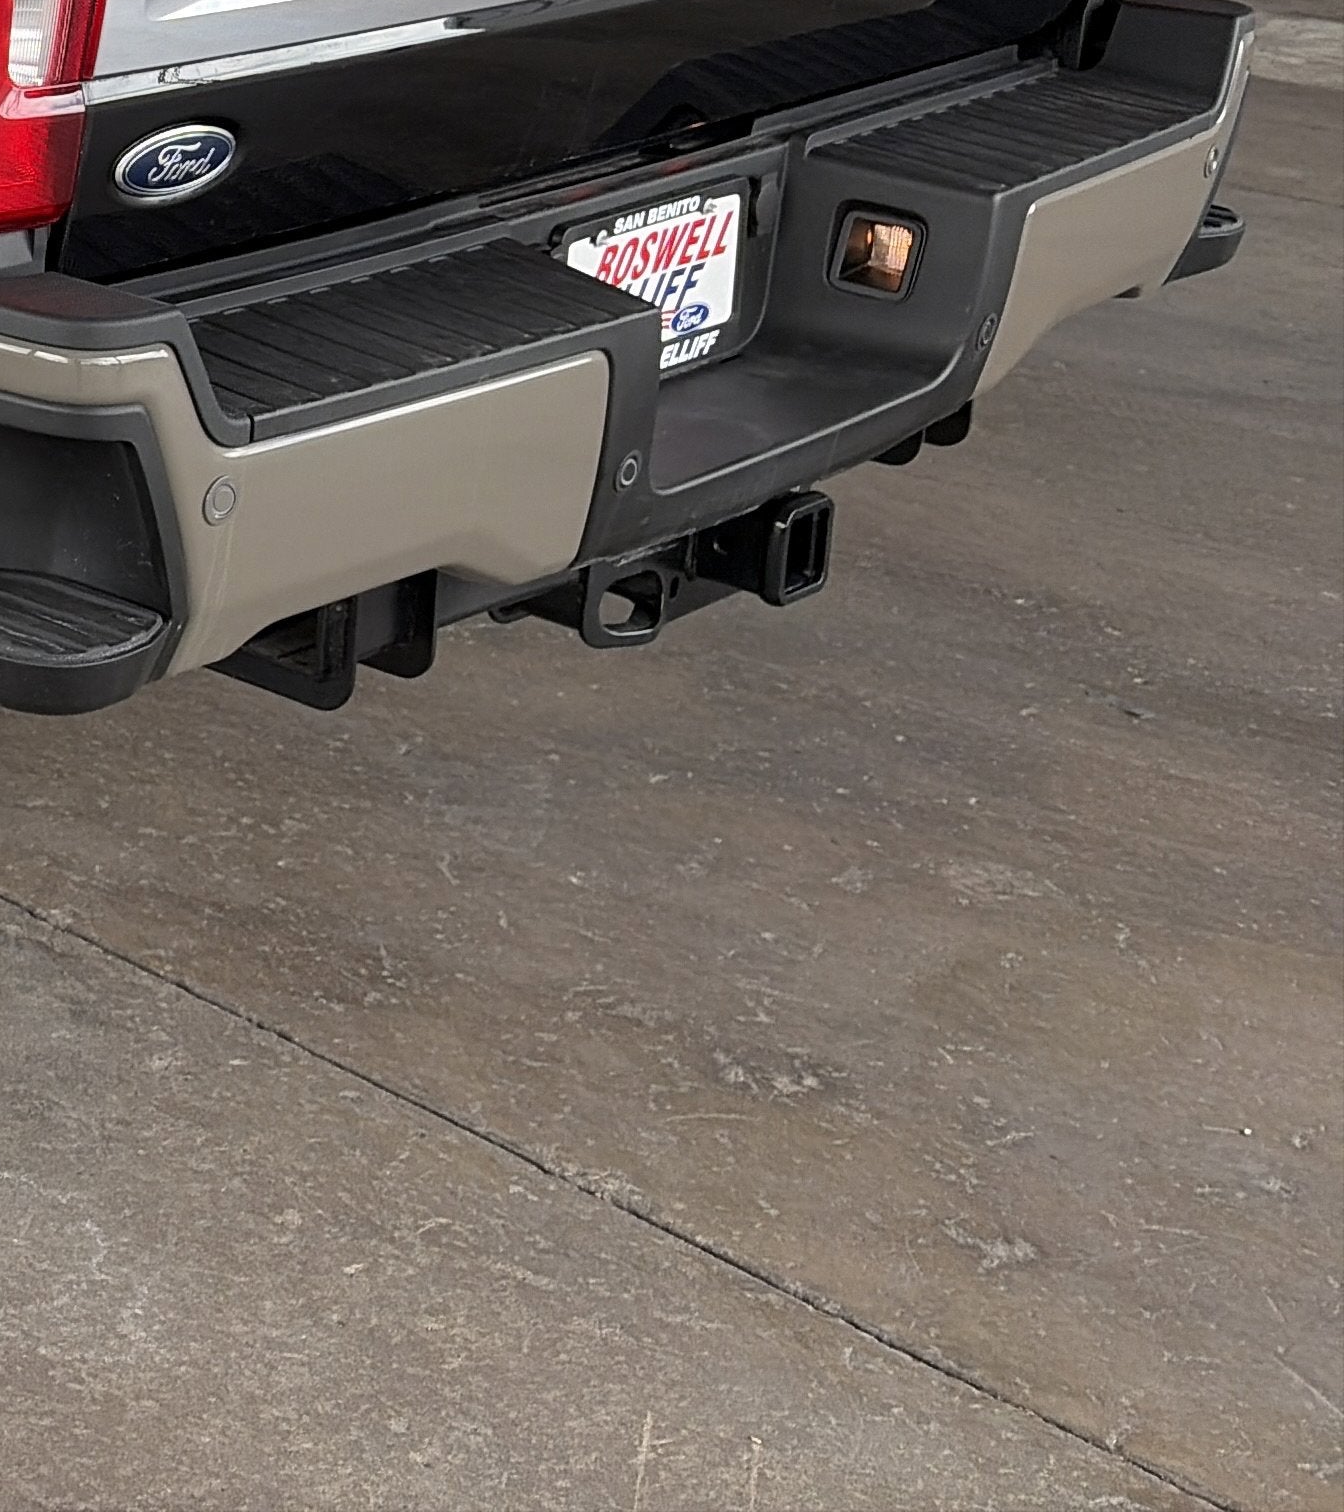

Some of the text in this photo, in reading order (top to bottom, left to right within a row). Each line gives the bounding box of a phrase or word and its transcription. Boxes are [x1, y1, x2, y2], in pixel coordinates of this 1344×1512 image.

[148, 141, 215, 183] Ford
[614, 195, 701, 235] SAN BENITO
[677, 307, 706, 332] Ford
[659, 329, 721, 370] ELLIFF
